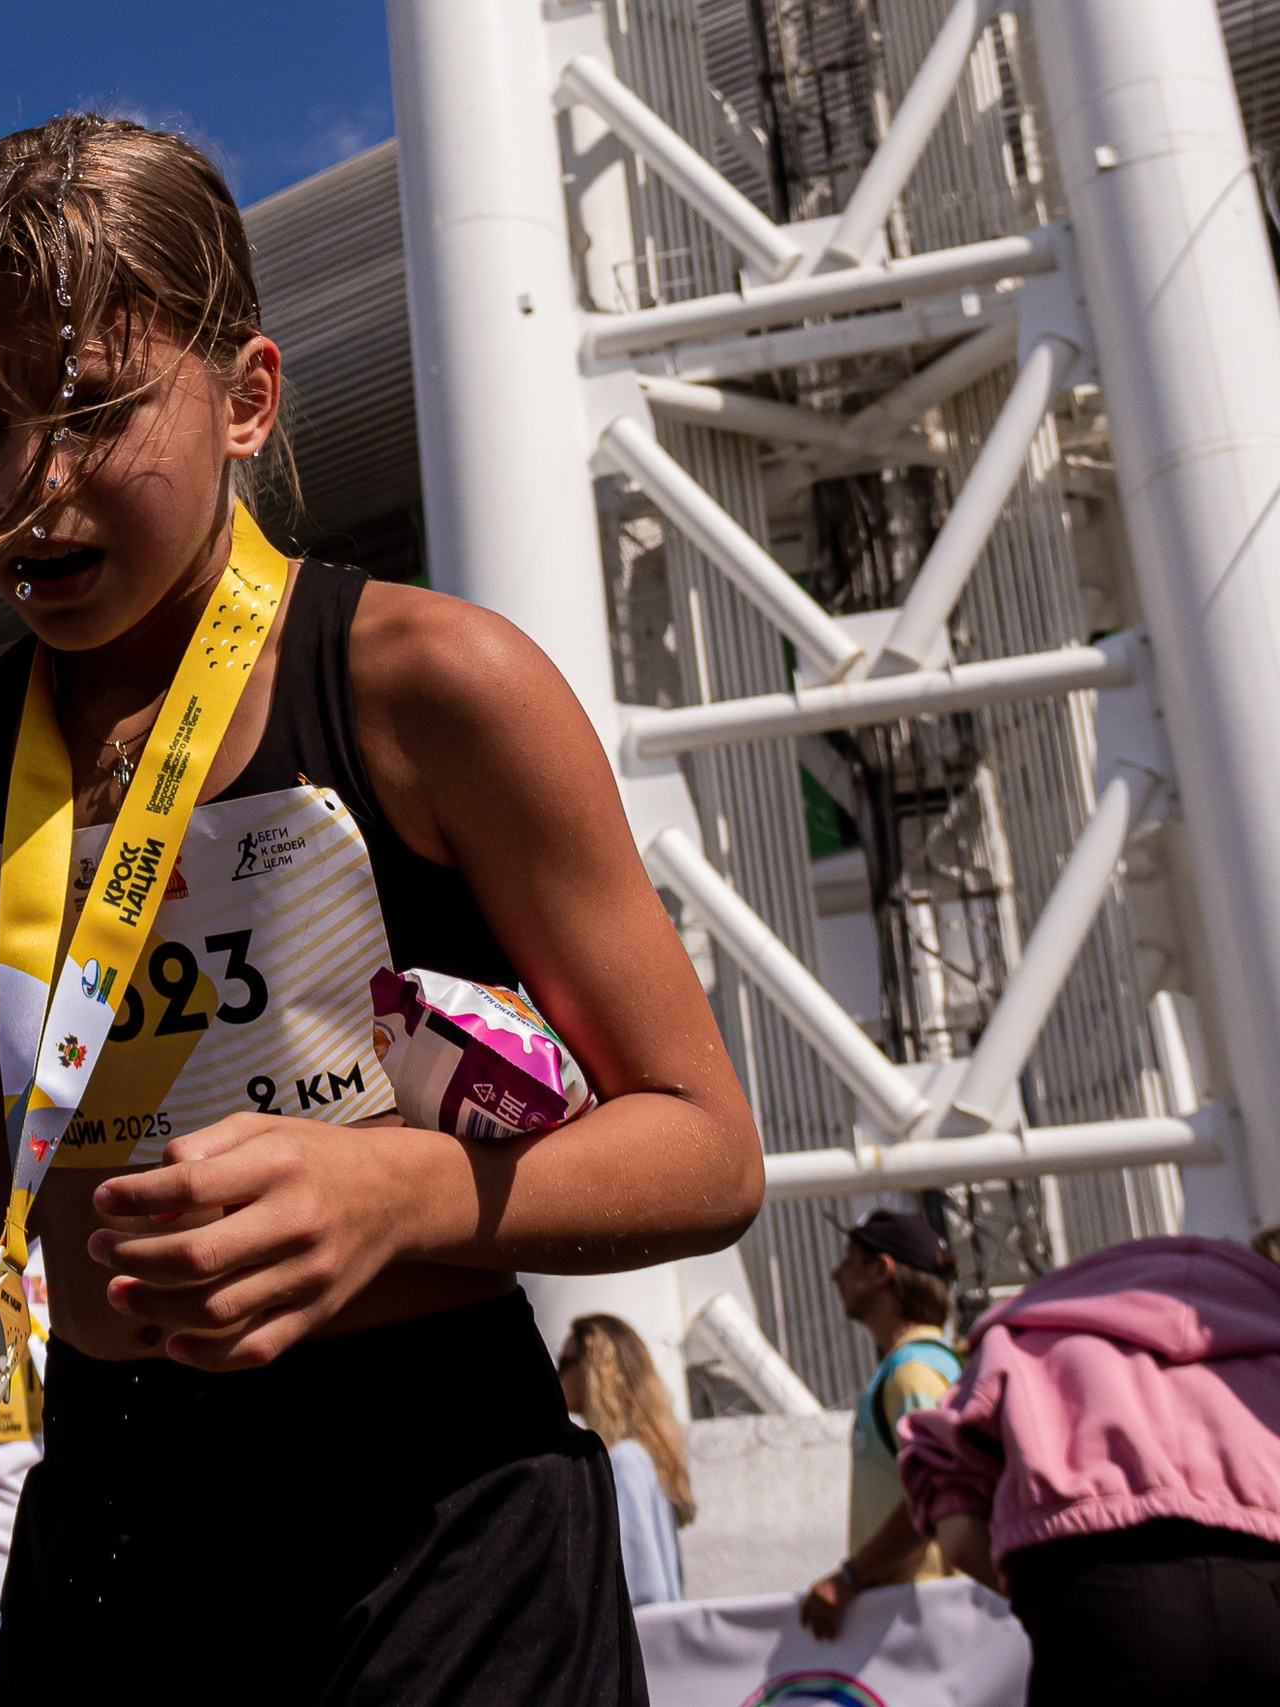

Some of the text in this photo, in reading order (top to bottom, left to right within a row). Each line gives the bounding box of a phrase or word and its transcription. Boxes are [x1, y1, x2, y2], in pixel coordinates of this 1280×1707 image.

[170, 732, 182, 750] бега
[257, 827, 289, 843] БЕГИ
[261, 837, 306, 856] К СВОЕЙ
[103, 841, 141, 908] КРОСС
[263, 855, 293, 871] ЦЕЛИ
[119, 837, 165, 927] НАЦИИ
[247, 1061, 365, 1115] 2 КМ
[496, 1090, 527, 1126] EAC
[113, 1112, 172, 1141] 2025
